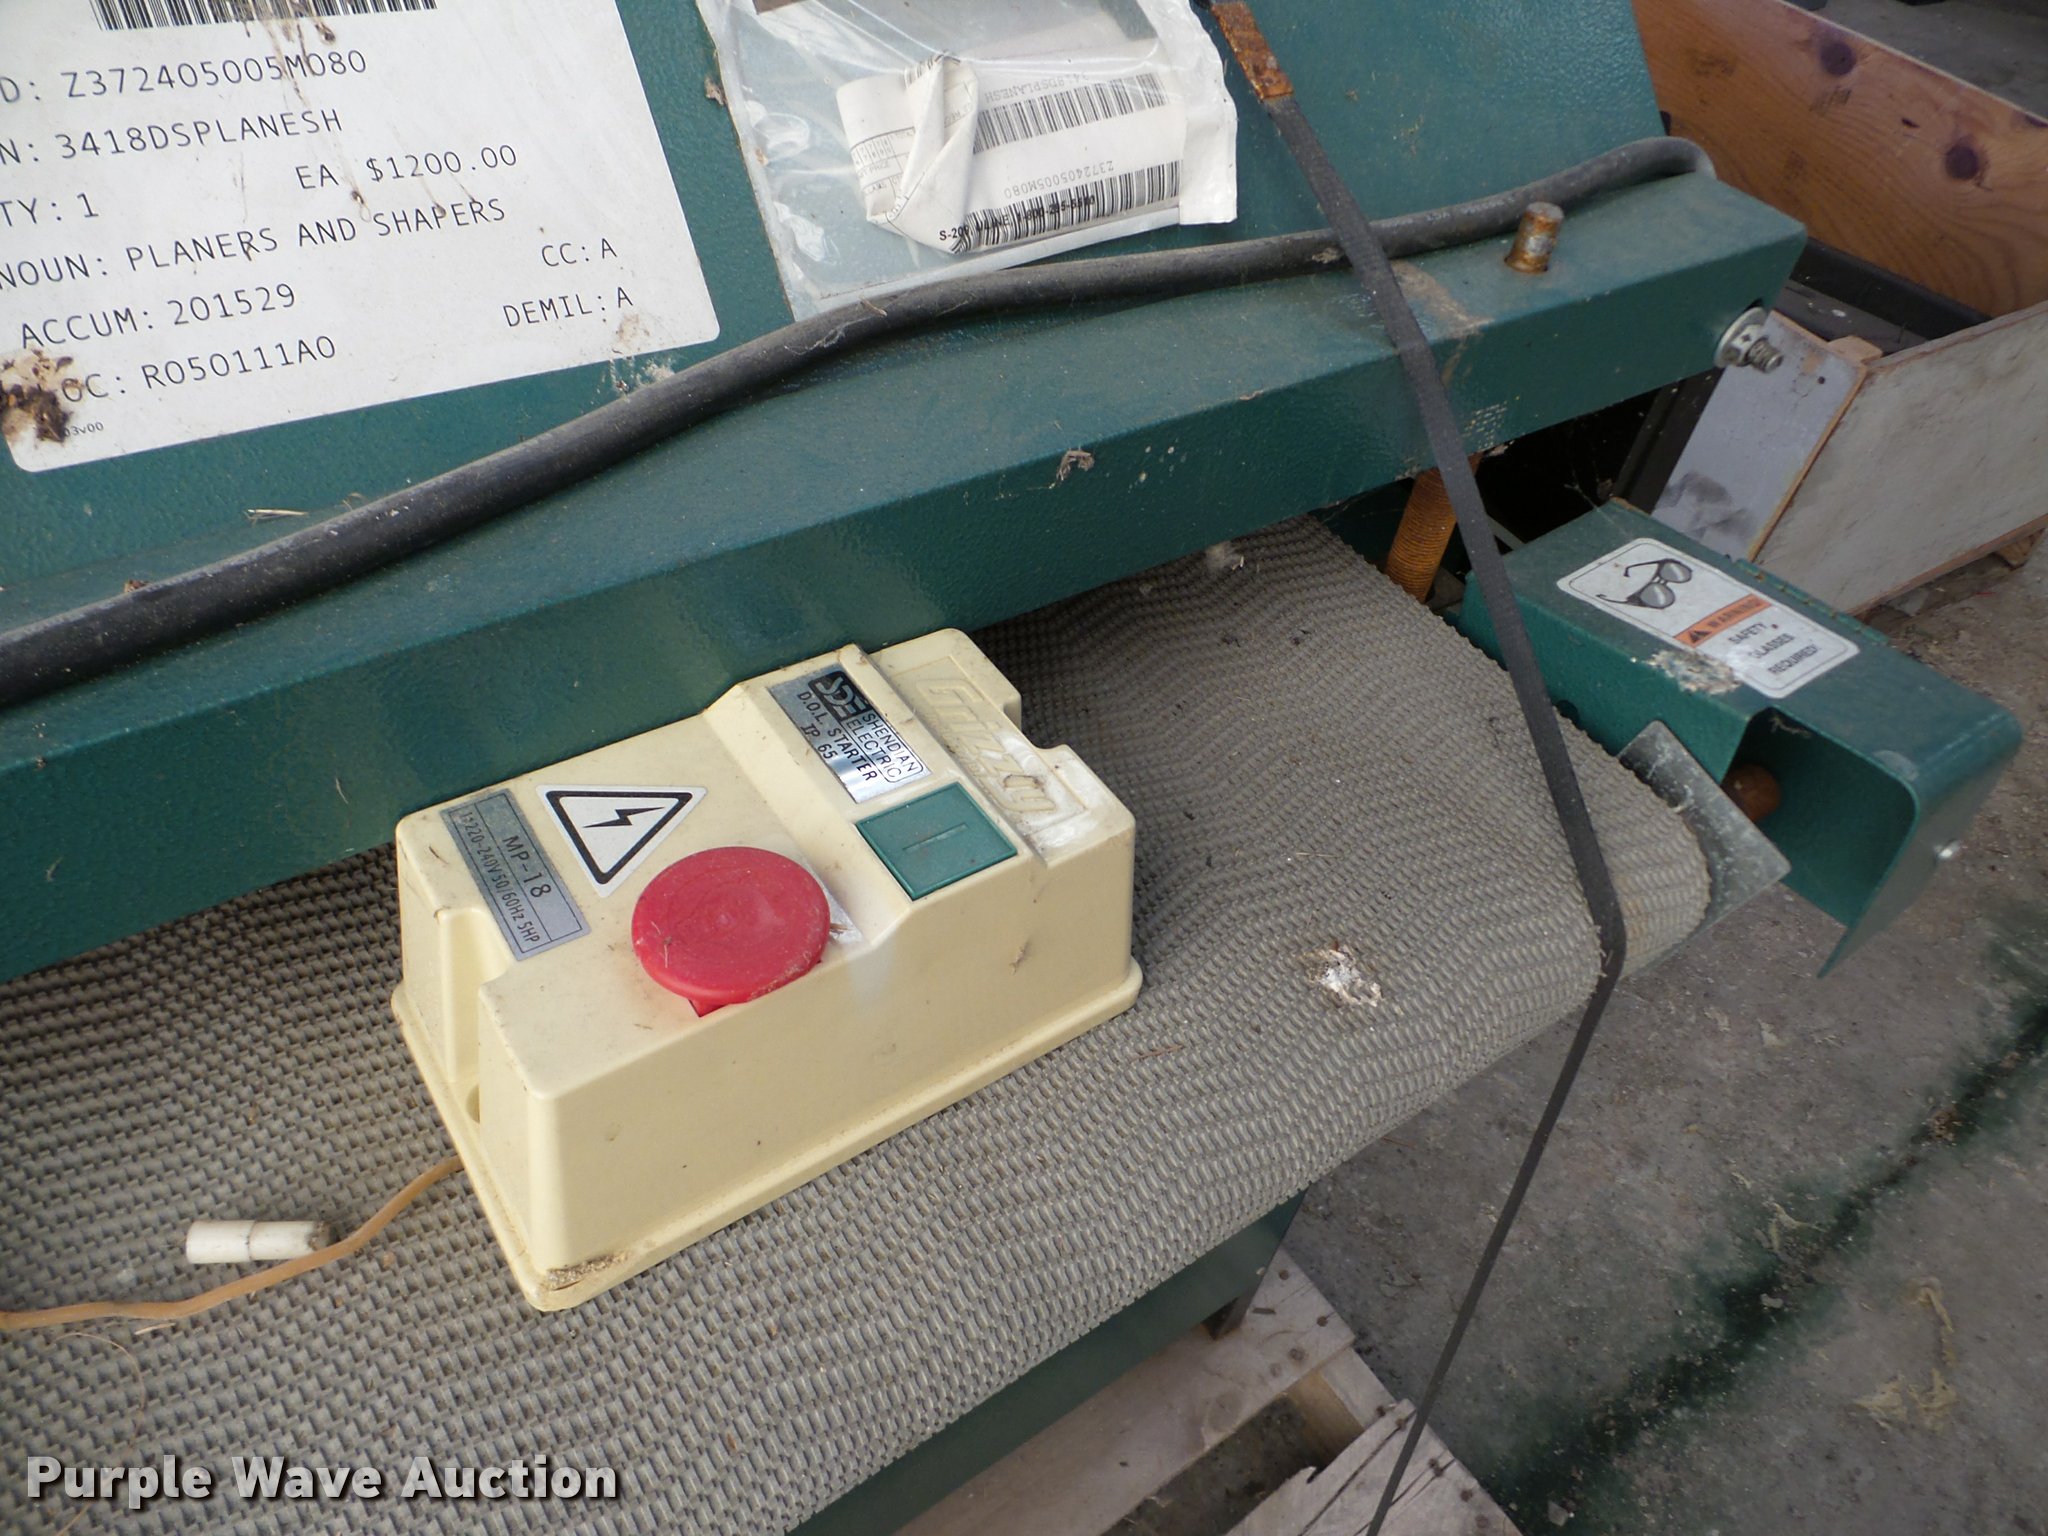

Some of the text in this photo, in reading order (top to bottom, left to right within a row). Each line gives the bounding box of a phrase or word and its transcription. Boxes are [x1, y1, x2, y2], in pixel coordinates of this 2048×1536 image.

[60, 49, 367, 98] Z372405005M080
[55, 108, 343, 159] 3418DSPLANESH
[296, 144, 517, 190] EA $1200.00
[1004, 160, 1115, 199] Z372405005M080
[77, 192, 99, 218] 1
[0, 198, 505, 290] NOUN: PLANERS AND SHAPERS
[22, 283, 296, 350] ACCUM: 201529
[40, 373, 126, 403] OC:
[1728, 621, 1767, 645] SAFETY
[797, 691, 878, 782] D.O.L. STARTER
[817, 743, 839, 760] 65
[845, 719, 903, 779] ELECTRIC
[861, 712, 920, 773] SHENDIAN
[502, 834, 552, 899] MP-18
[517, 921, 541, 943] 5HP
